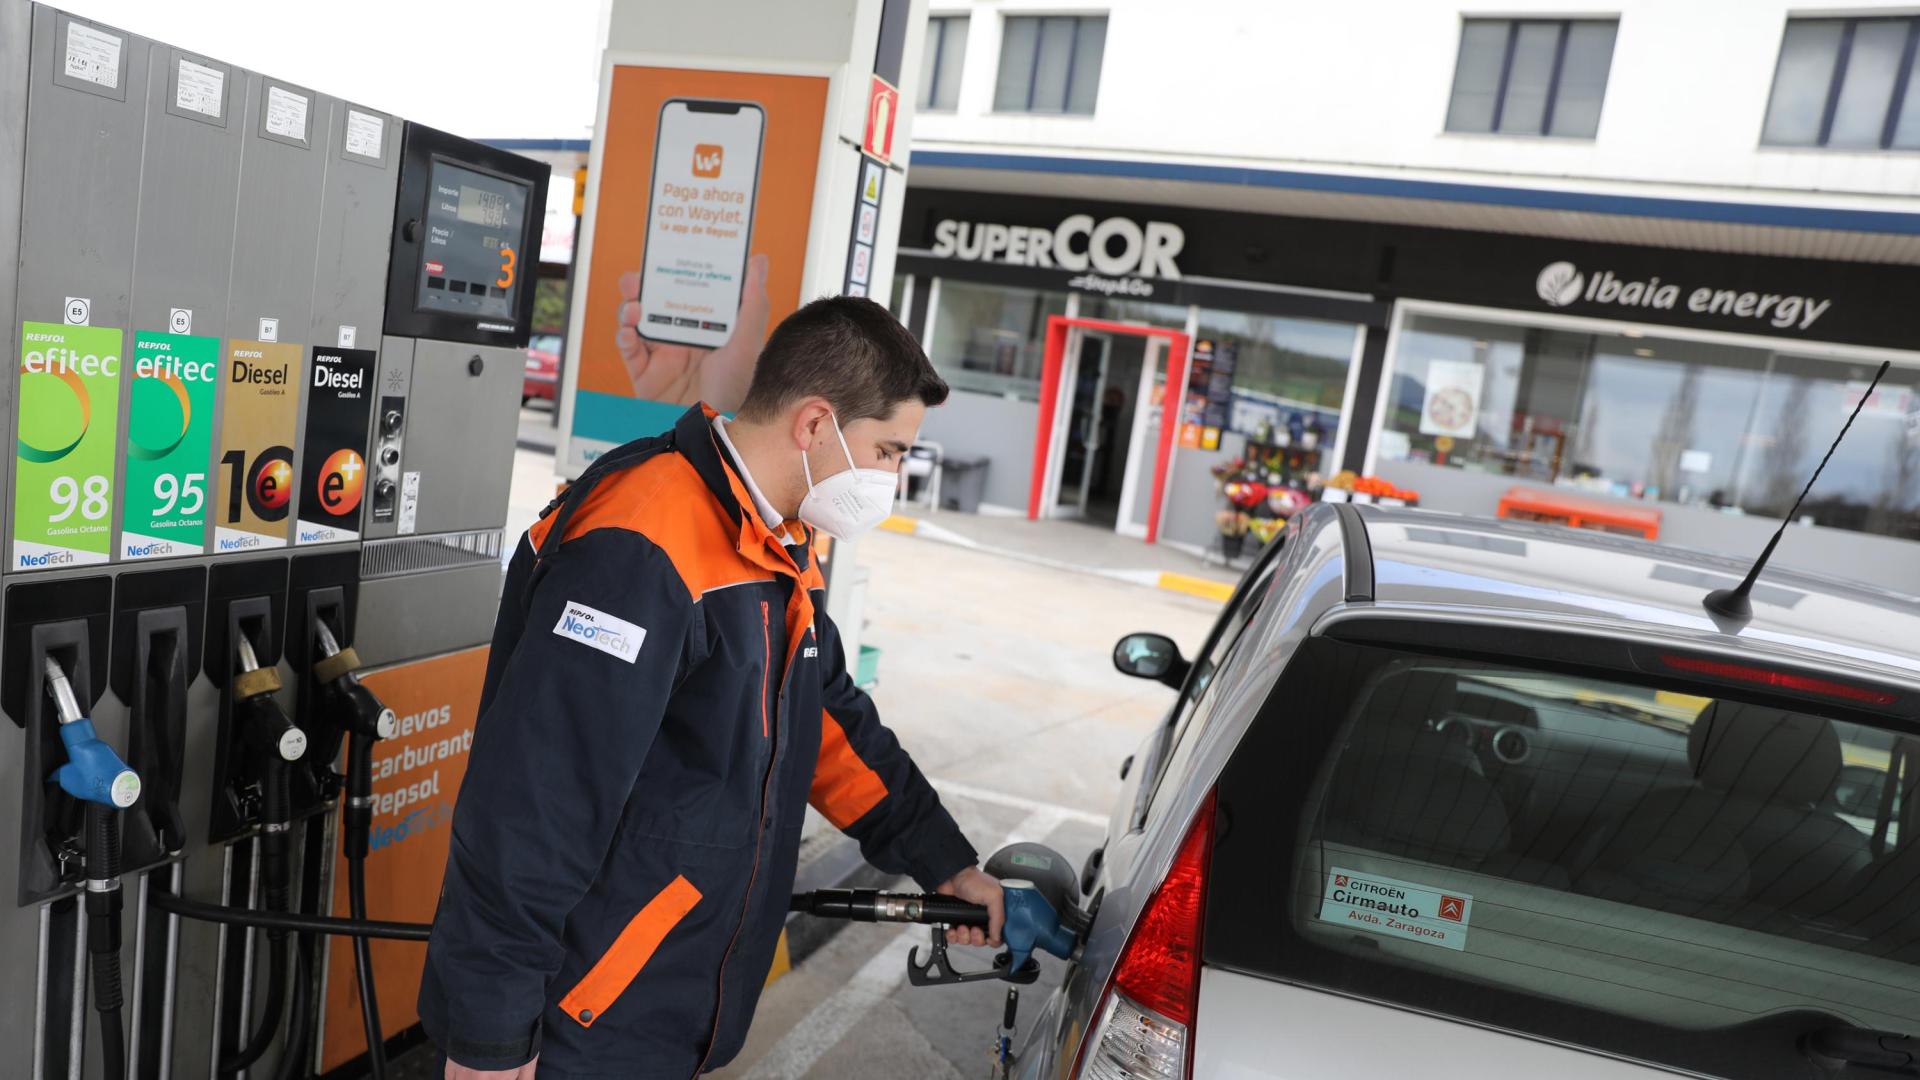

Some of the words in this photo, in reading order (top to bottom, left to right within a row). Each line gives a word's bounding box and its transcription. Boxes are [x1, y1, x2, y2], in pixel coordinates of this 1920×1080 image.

[663, 183, 699, 202] Paga
[703, 186, 745, 204] ahora
[658, 205, 684, 217] con
[932, 214, 1185, 280] SUPERCOR
[496, 248, 516, 288] 3
[1585, 271, 1680, 310] Ibaia
[1687, 287, 1832, 330] energy
[72, 307, 82, 316] E5
[176, 317, 185, 326] E5
[26, 333, 65, 343] REPSOL
[138, 340, 172, 351] REPSOL
[24, 347, 118, 377] efitec
[233, 350, 263, 358] REPSOL
[316, 355, 342, 363] REPSOL
[136, 355, 215, 383] efitec
[232, 360, 288, 385] Diesel
[314, 365, 363, 389] Diesel
[48, 475, 109, 523] 98
[152, 473, 205, 517] 95
[48, 527, 78, 536] Gasolina
[150, 520, 177, 529] Gasolina
[220, 536, 260, 550] NeoTech
[300, 529, 336, 542] NeoTech
[127, 542, 173, 556] NeoTech
[20, 551, 74, 567] NeoTech
[569, 608, 595, 623] REPSOL
[562, 615, 630, 654] NeoTech
[371, 729, 475, 782] carburant
[1350, 881, 1406, 900] CITROËN
[1333, 889, 1419, 918] Cirmauto
[1348, 910, 1382, 925] Avda.
[1386, 918, 1445, 940] Zaragoza
